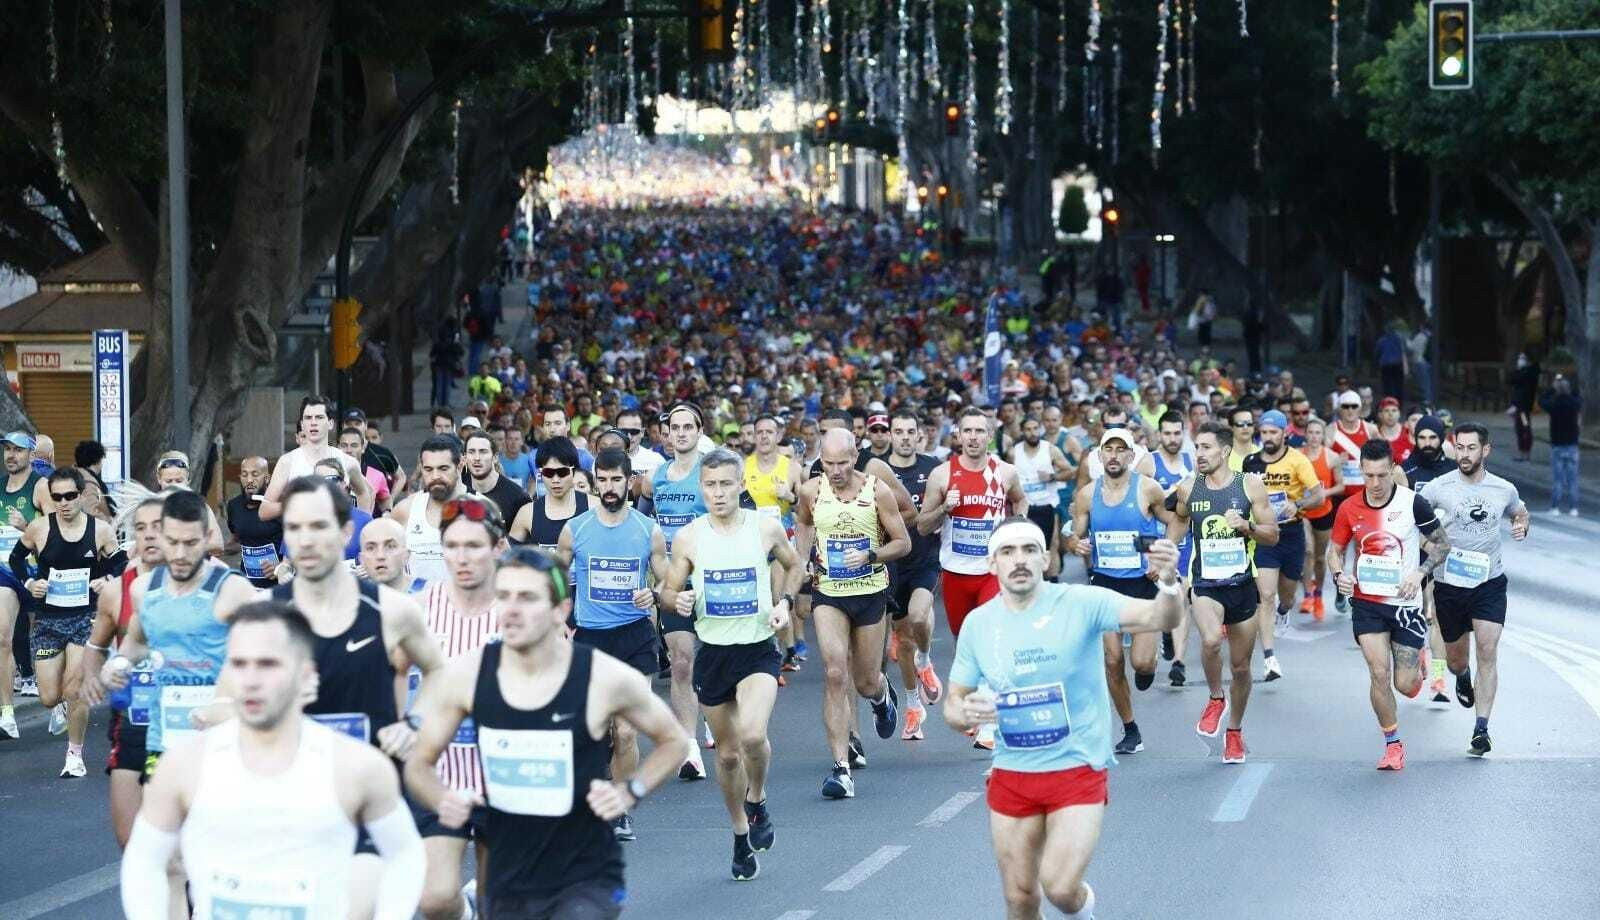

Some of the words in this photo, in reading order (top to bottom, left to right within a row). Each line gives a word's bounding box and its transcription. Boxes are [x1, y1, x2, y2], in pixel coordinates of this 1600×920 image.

[98, 336, 121, 353] BUS
[101, 374, 117, 386] 32
[101, 386, 117, 397] 35
[101, 399, 117, 411] 36
[963, 495, 1002, 509] MONACO
